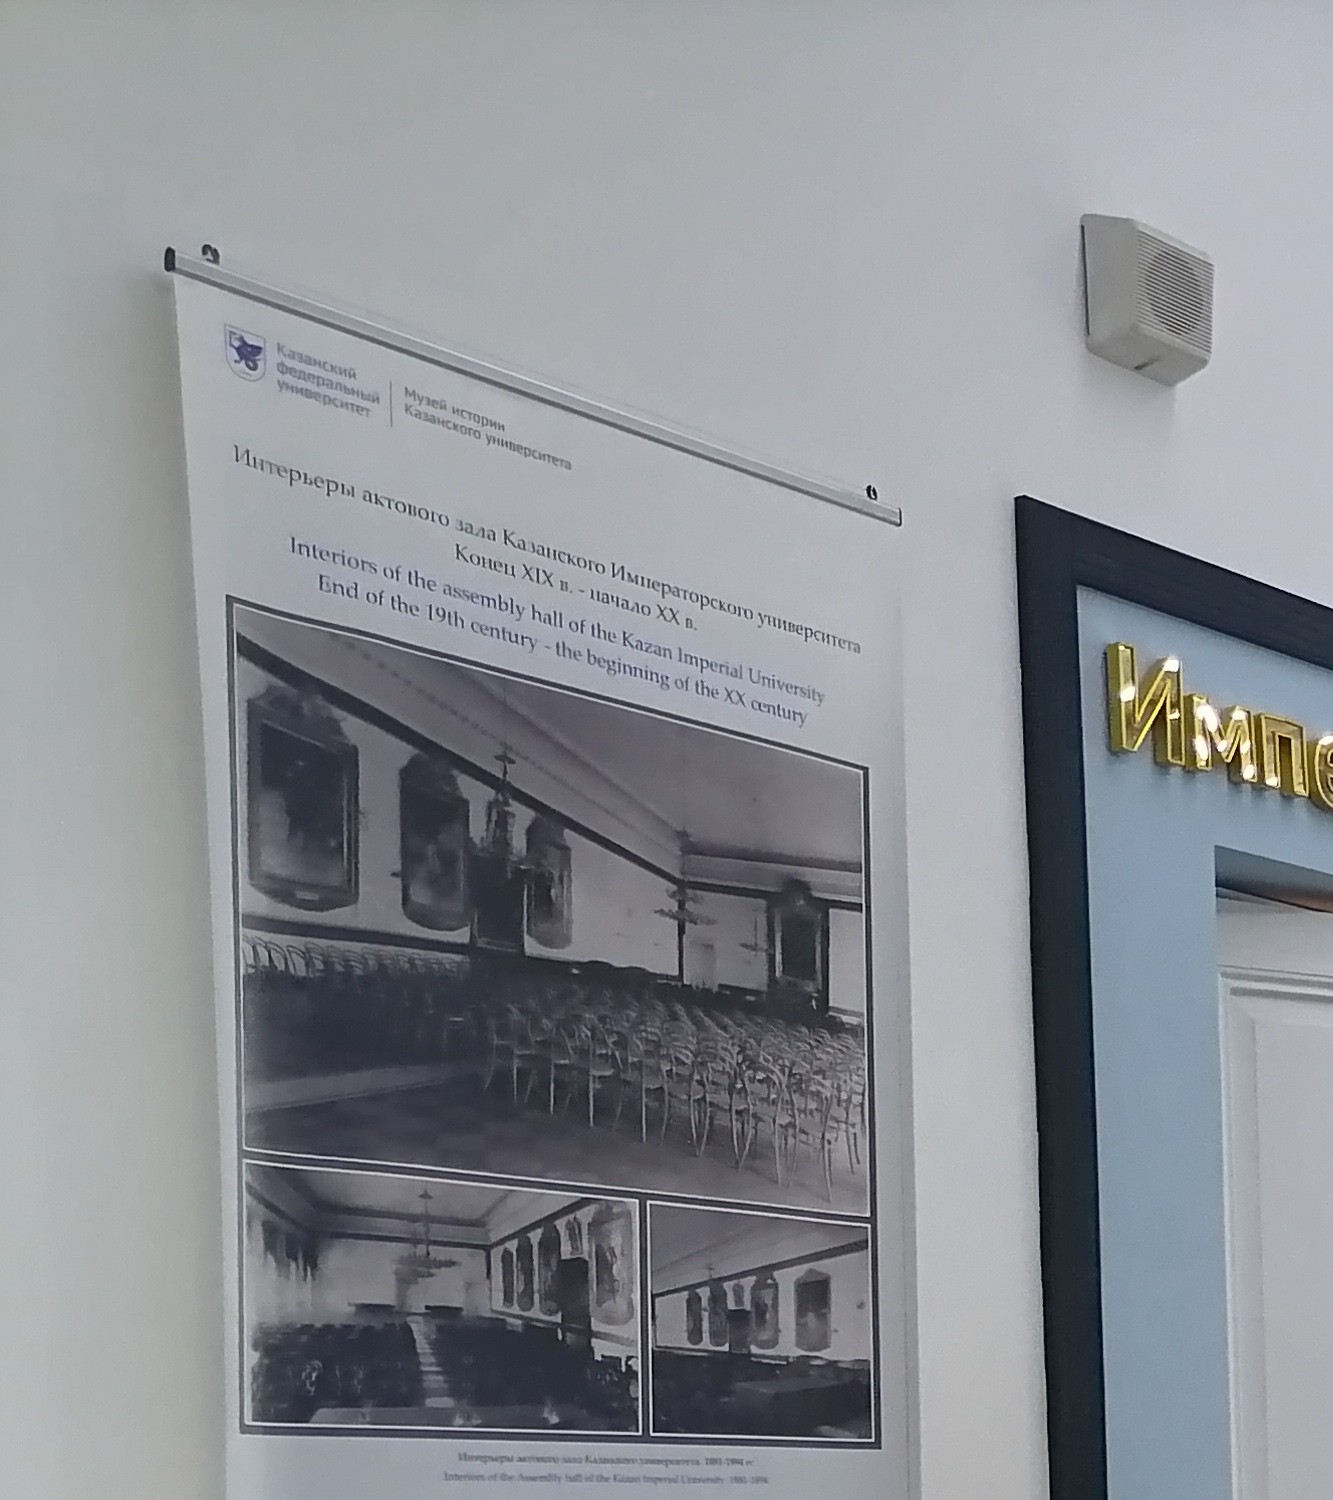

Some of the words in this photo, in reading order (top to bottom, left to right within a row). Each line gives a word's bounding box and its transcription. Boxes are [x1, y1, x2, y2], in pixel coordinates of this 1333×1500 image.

[276, 341, 358, 381] Казанский
[276, 360, 380, 406] федеральный
[276, 379, 371, 418] университет
[404, 386, 447, 412] Музей
[452, 403, 506, 433] истории
[404, 404, 482, 440] Казанского
[485, 432, 573, 472] университета
[234, 444, 356, 498] Интерьеры
[362, 490, 450, 527] актового
[455, 518, 497, 542] зала
[503, 528, 606, 575] Казанского
[611, 562, 754, 621] Императорского
[758, 612, 862, 654] университета
[290, 536, 378, 576] Interiors
[384, 566, 403, 583] of
[408, 570, 438, 592] the
[442, 584, 526, 622] assembly
[531, 602, 563, 629] hall
[569, 619, 588, 634] of
[591, 623, 618, 644] the
[621, 630, 673, 661] Kazan
[678, 647, 744, 681] Imperial
[749, 667, 825, 707] University
[455, 544, 516, 577] Конец
[522, 563, 555, 588] XIX
[559, 578, 574, 594] в.
[590, 589, 652, 617] начало
[656, 604, 681, 626] XX
[685, 617, 698, 631] в.
[318, 574, 359, 600] End
[366, 590, 386, 606] of
[391, 594, 420, 617] the
[426, 603, 465, 630] 19th
[471, 618, 538, 651] century
[555, 641, 583, 662] the
[587, 648, 670, 691] beginning
[674, 676, 690, 692] of
[695, 679, 720, 699] the
[724, 686, 747, 708] XX
[751, 700, 808, 729] century
